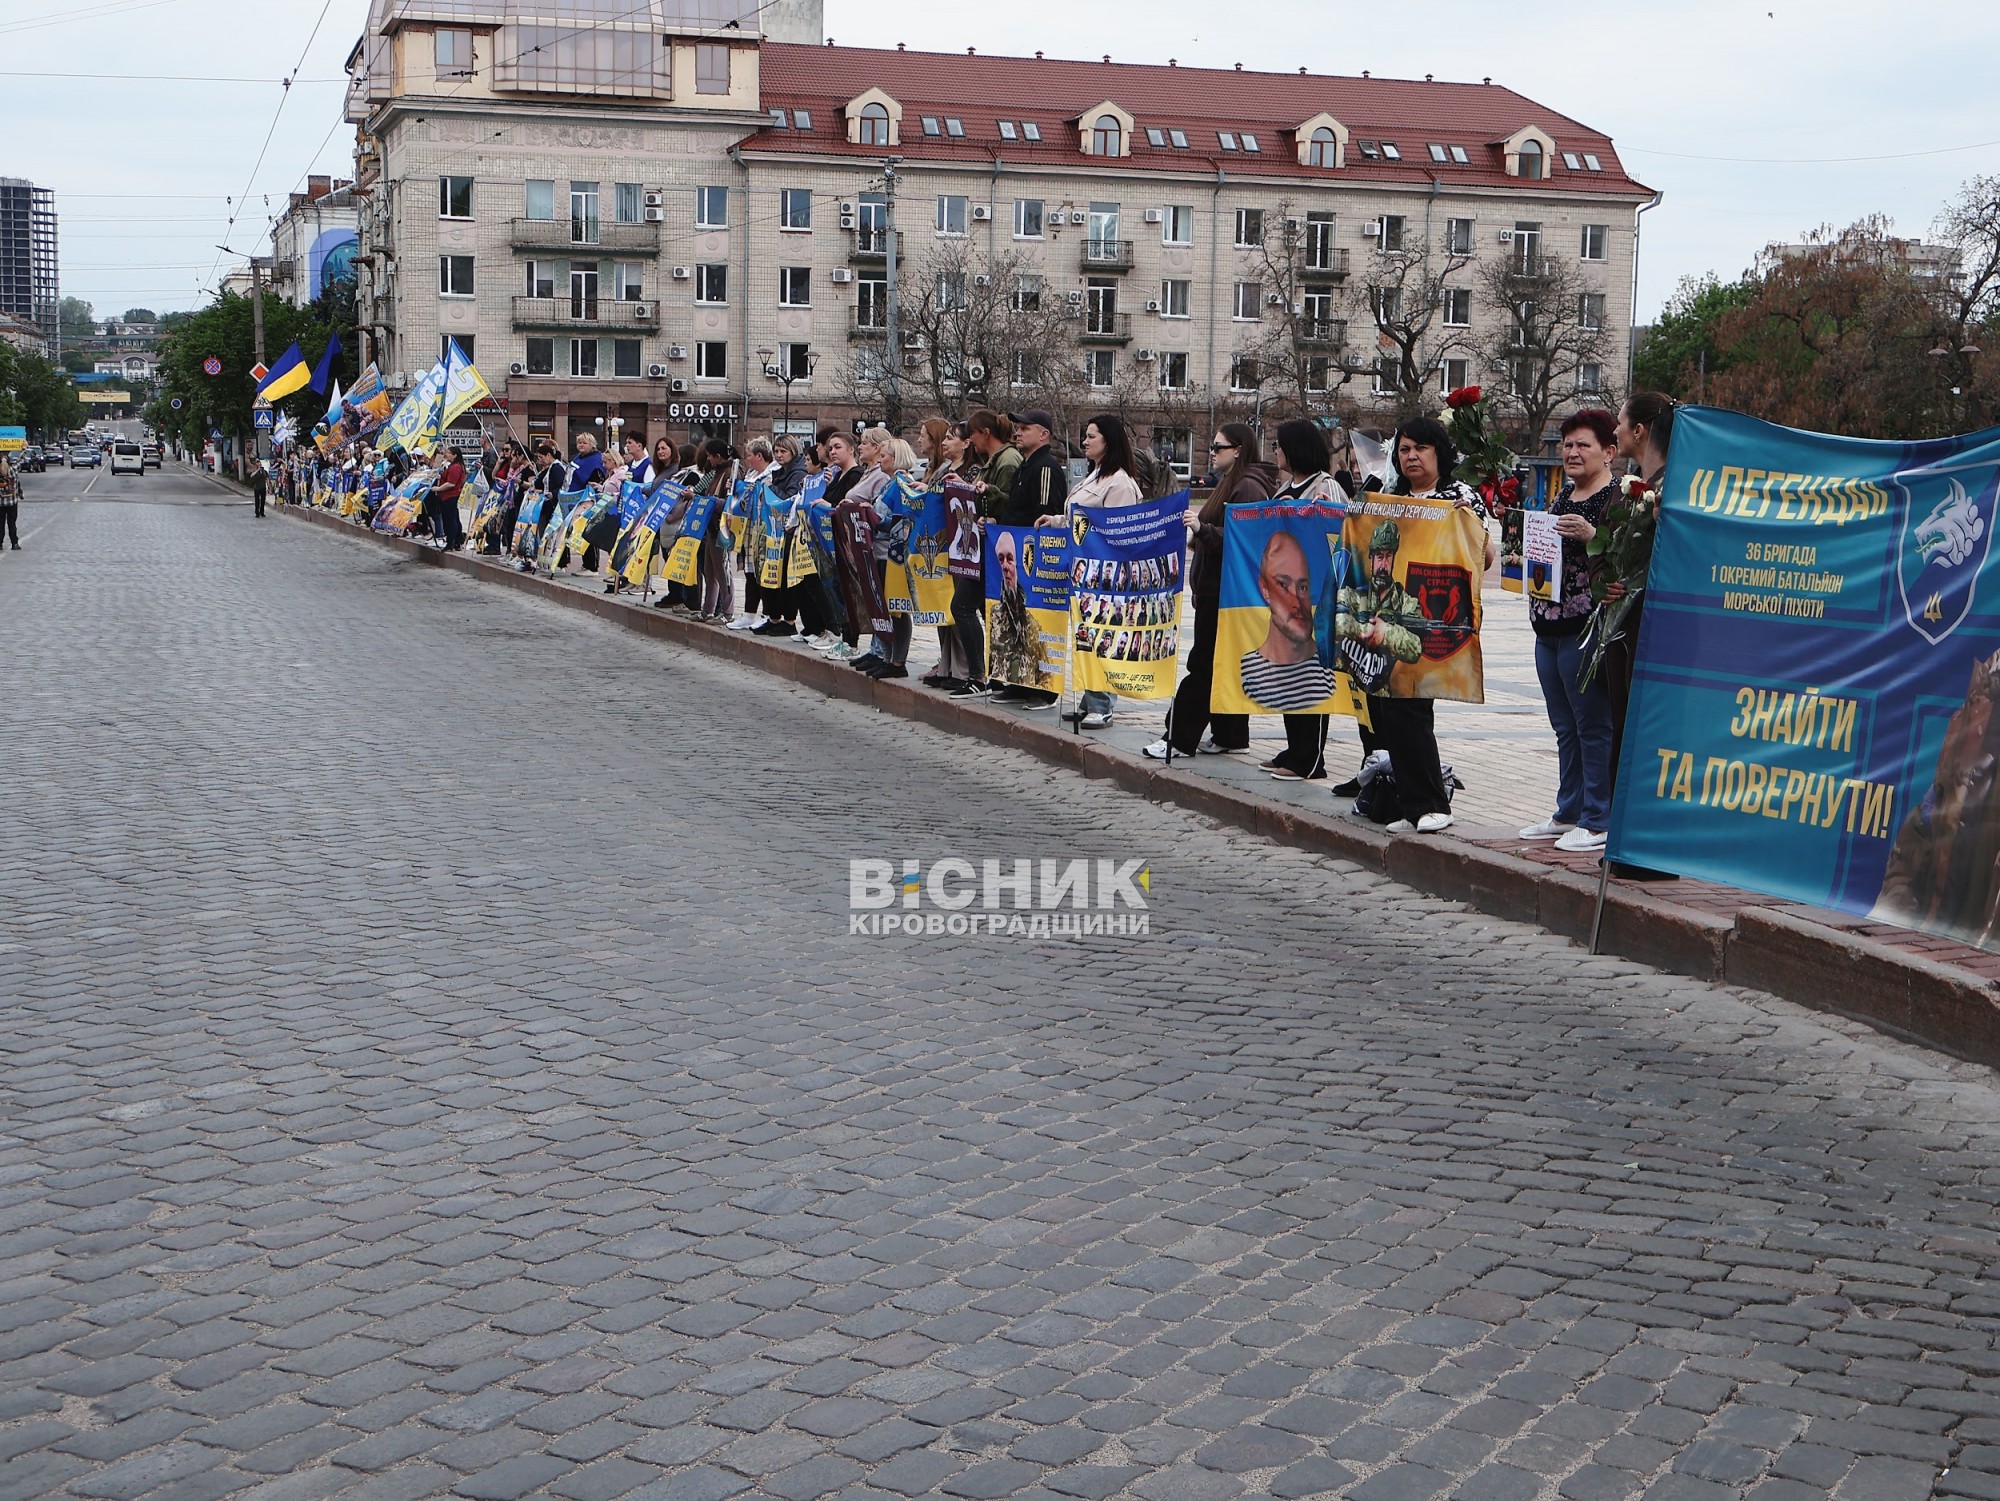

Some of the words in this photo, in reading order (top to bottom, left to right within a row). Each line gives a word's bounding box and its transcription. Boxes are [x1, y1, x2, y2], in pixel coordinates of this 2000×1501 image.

[669, 403, 738, 418] GOGOL
[1164, 511, 1183, 524] ОБЛАСТ
[1363, 502, 1405, 518] ОЛЕКСАНДР
[1405, 504, 1449, 521] СЕРГІЙОВИЧ
[1745, 542, 1761, 561] 36
[1764, 543, 1817, 566] БРИГАДА
[1427, 578, 1451, 586] СТРАХ
[1711, 564, 1717, 582] 1
[1719, 566, 1776, 588] ОКРЕМИЙ
[1778, 570, 1844, 593] БАТАЛЬЙОН
[1723, 591, 1783, 614] МОРСЬКОЇ
[1784, 597, 1825, 619] ПІХОТИ
[1130, 673, 1140, 683] ЦЕ
[1730, 686, 1857, 753] ЗНАЙТИ
[1656, 748, 1693, 803] ТА
[1700, 756, 1894, 839] ПОВЕРНУТИ!
